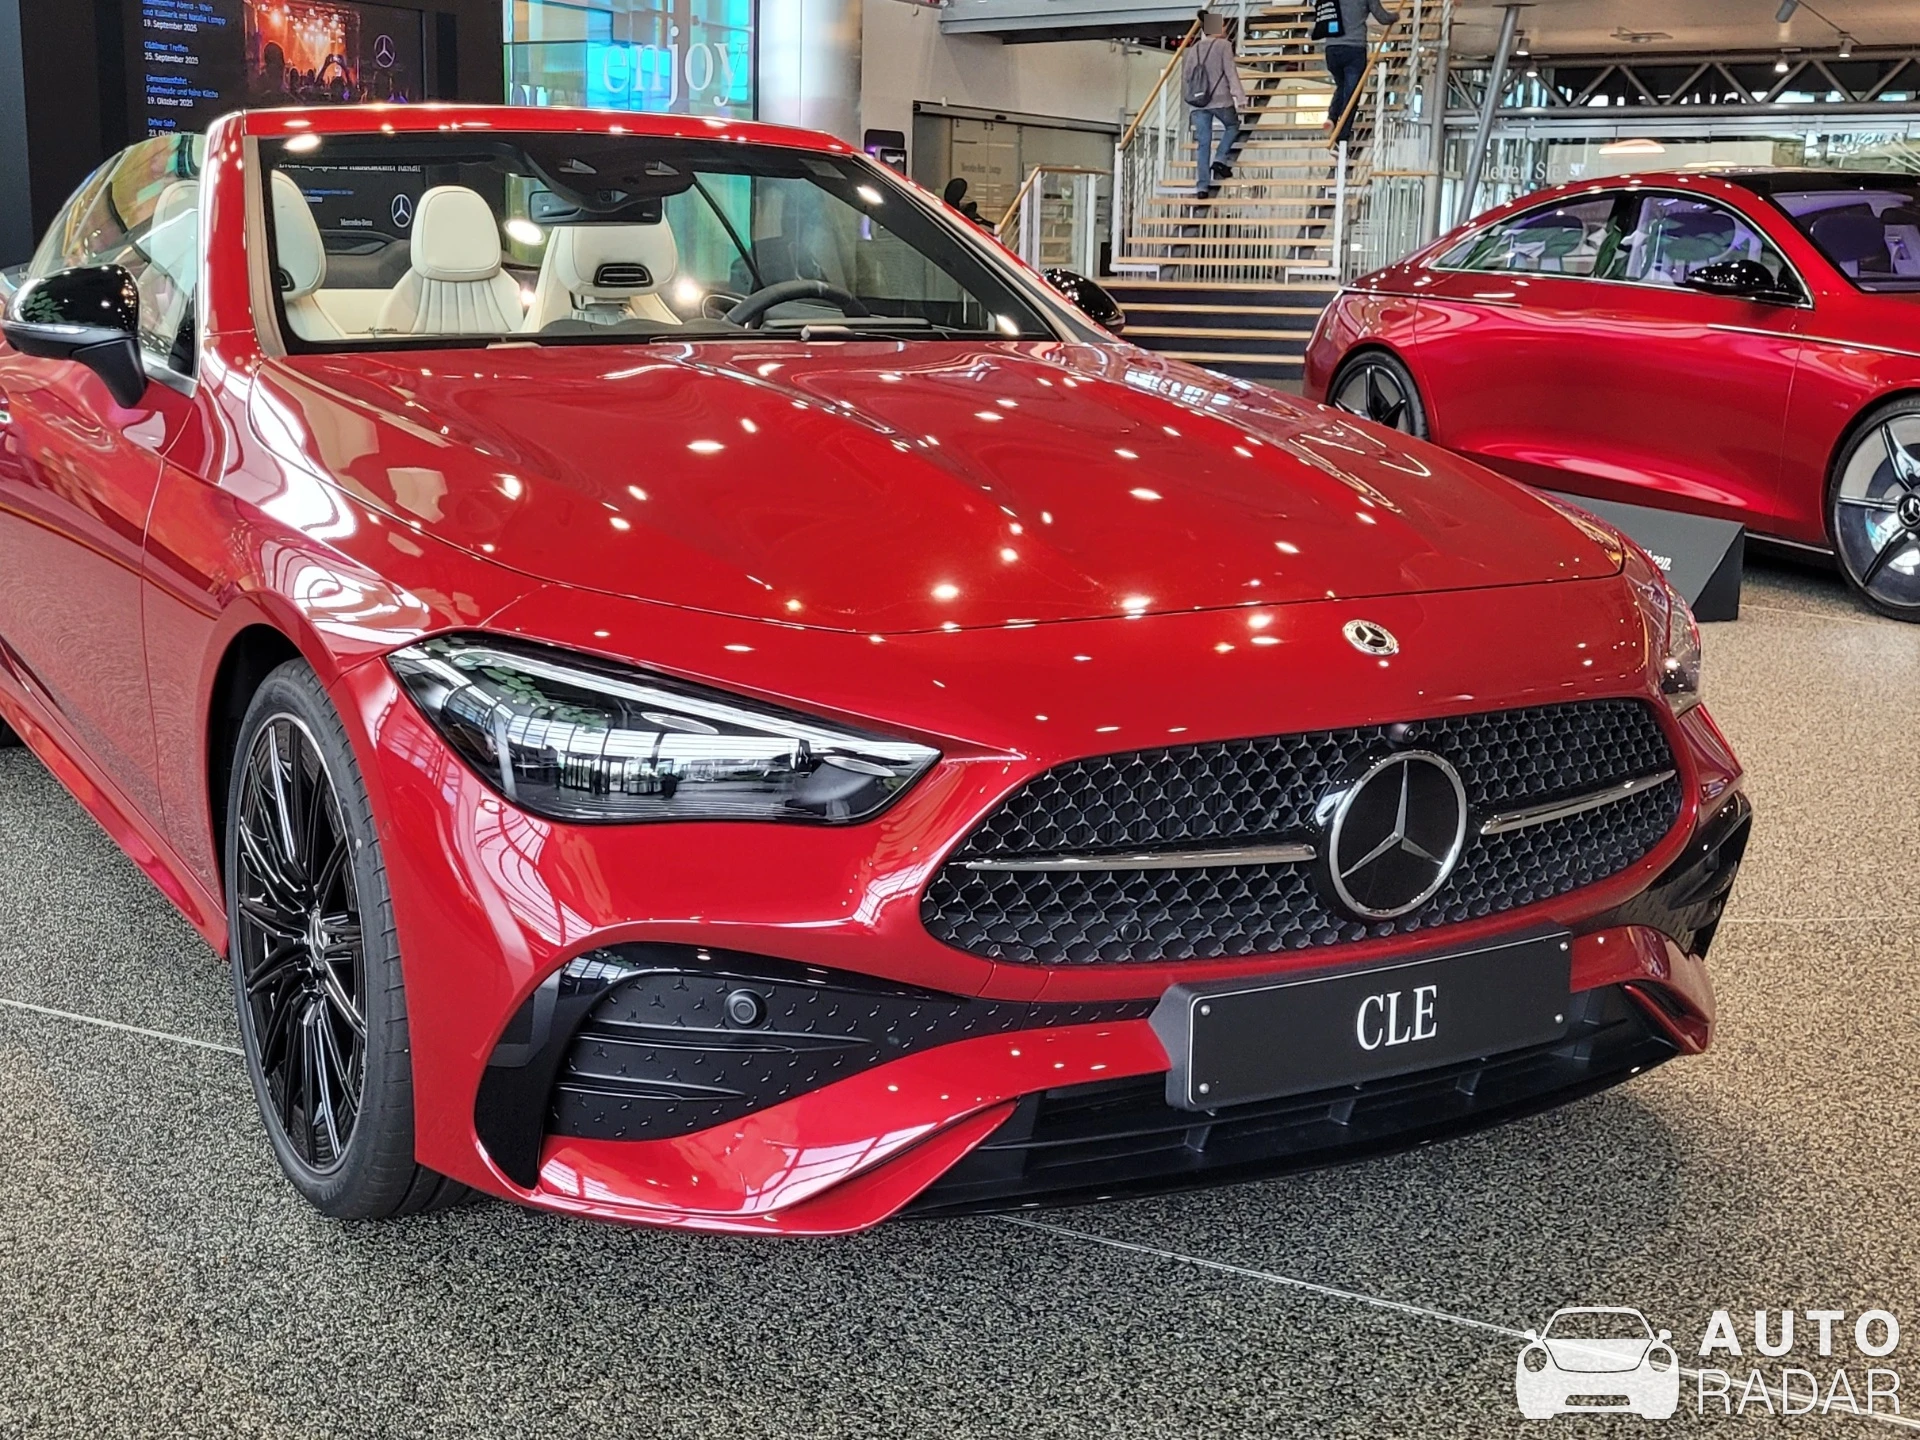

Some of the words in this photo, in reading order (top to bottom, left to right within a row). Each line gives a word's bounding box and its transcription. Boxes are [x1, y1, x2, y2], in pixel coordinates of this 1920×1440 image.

[153, 20, 183, 30] September
[183, 23, 198, 32] 2025
[154, 53, 184, 63] September
[184, 56, 199, 65] 2025
[603, 26, 749, 107] enjoy
[156, 97, 179, 107] Oktober
[179, 99, 194, 107] 2025
[1356, 985, 1438, 1051] CLE
